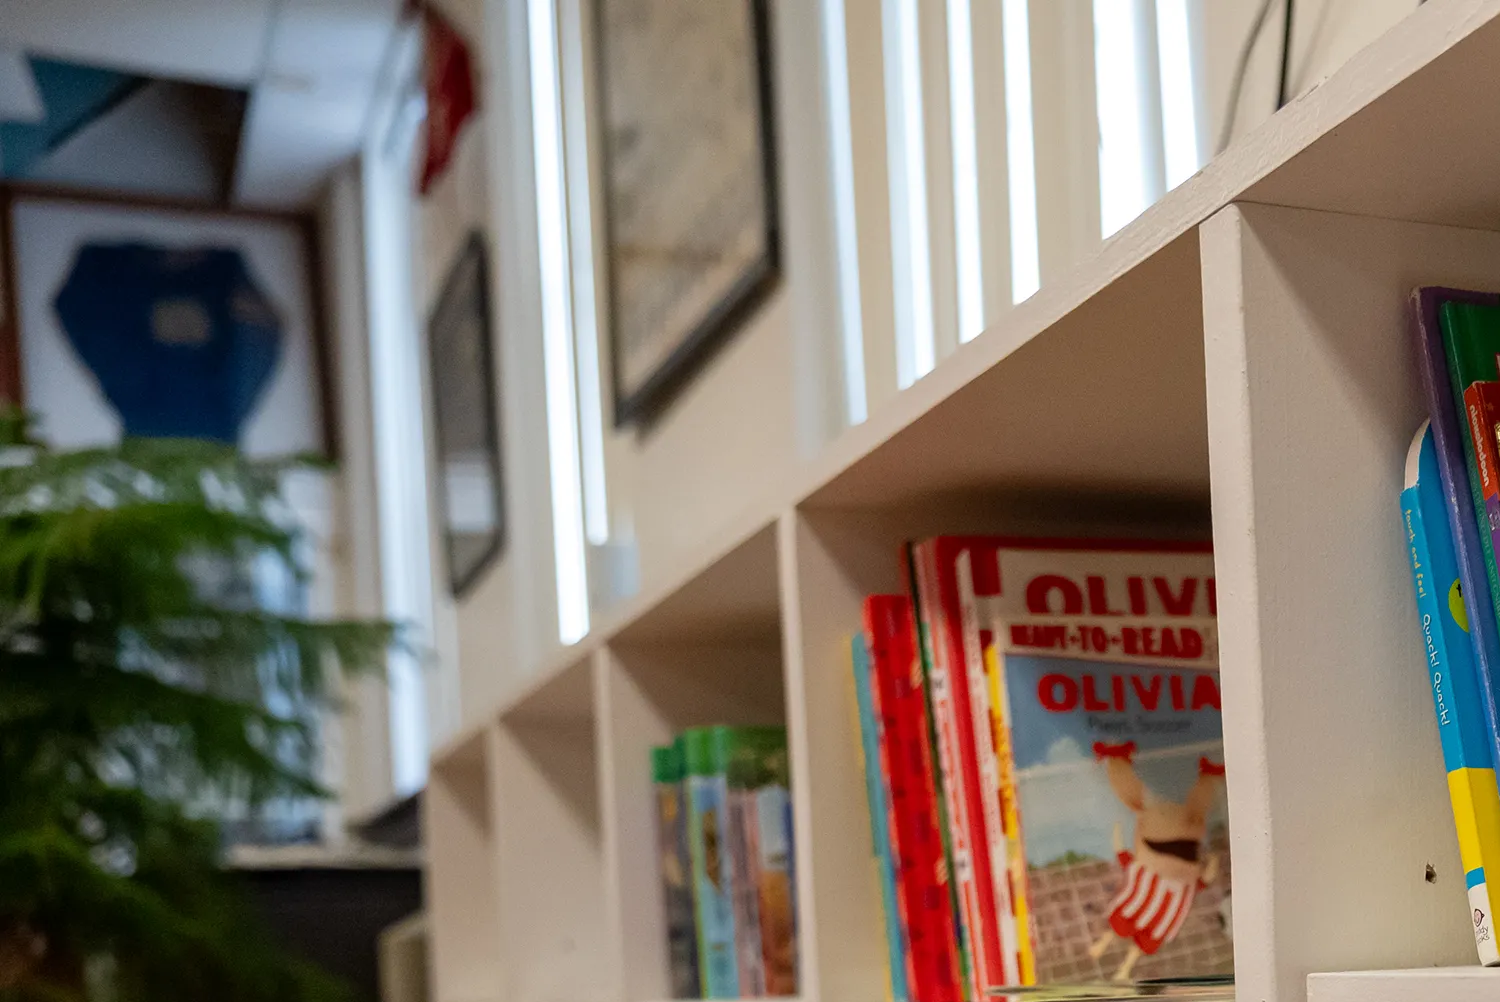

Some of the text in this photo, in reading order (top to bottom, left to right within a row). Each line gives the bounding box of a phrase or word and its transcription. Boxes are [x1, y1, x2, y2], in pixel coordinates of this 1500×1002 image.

[1469, 404, 1489, 487] nickelodeon
[1405, 508, 1427, 598] touch and feel
[1026, 574, 1217, 617] OLIVI
[1037, 672, 1222, 713] OLIVIA
[1422, 613, 1451, 726] Quack! Quack!
